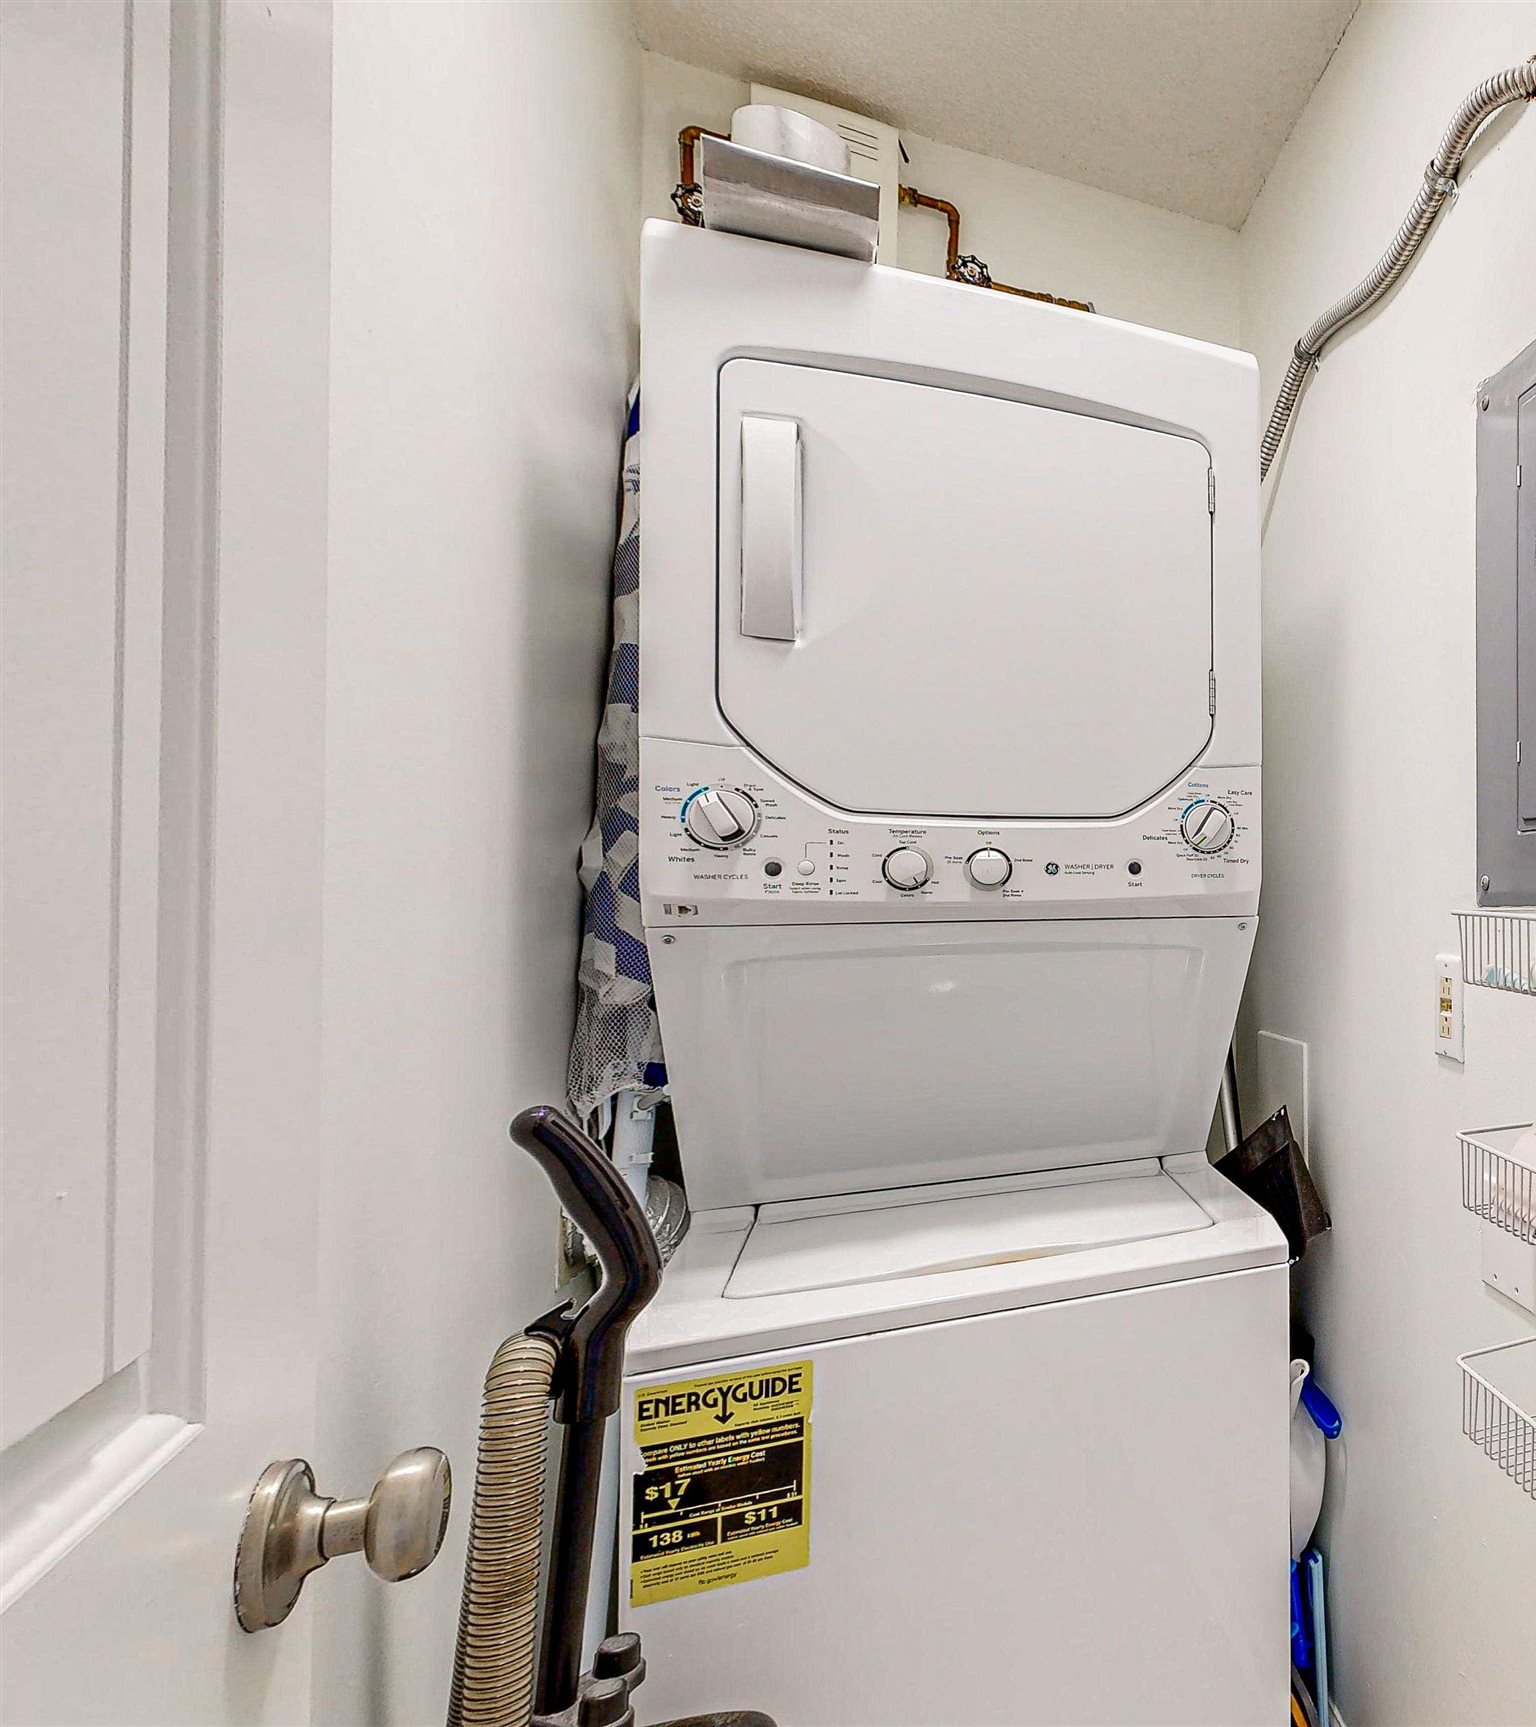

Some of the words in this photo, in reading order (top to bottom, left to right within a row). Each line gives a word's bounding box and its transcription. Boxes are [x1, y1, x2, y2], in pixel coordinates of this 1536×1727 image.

[638, 1373, 802, 1421] ENERGYGUIDE
[669, 1443, 688, 1452] ONLY
[697, 1439, 714, 1447] other
[715, 1434, 735, 1443] labels
[736, 1432, 750, 1440] with
[750, 1429, 771, 1438] yellow
[771, 1423, 800, 1433] numbers.
[675, 1462, 707, 1474] Estimated
[708, 1458, 727, 1467] Yearly
[728, 1455, 750, 1463] Energy
[750, 1450, 766, 1458] Cost
[645, 1478, 691, 1501] $17
[744, 1506, 778, 1524] $11
[649, 1530, 683, 1548] 138
[681, 1543, 704, 1552] Electricity
